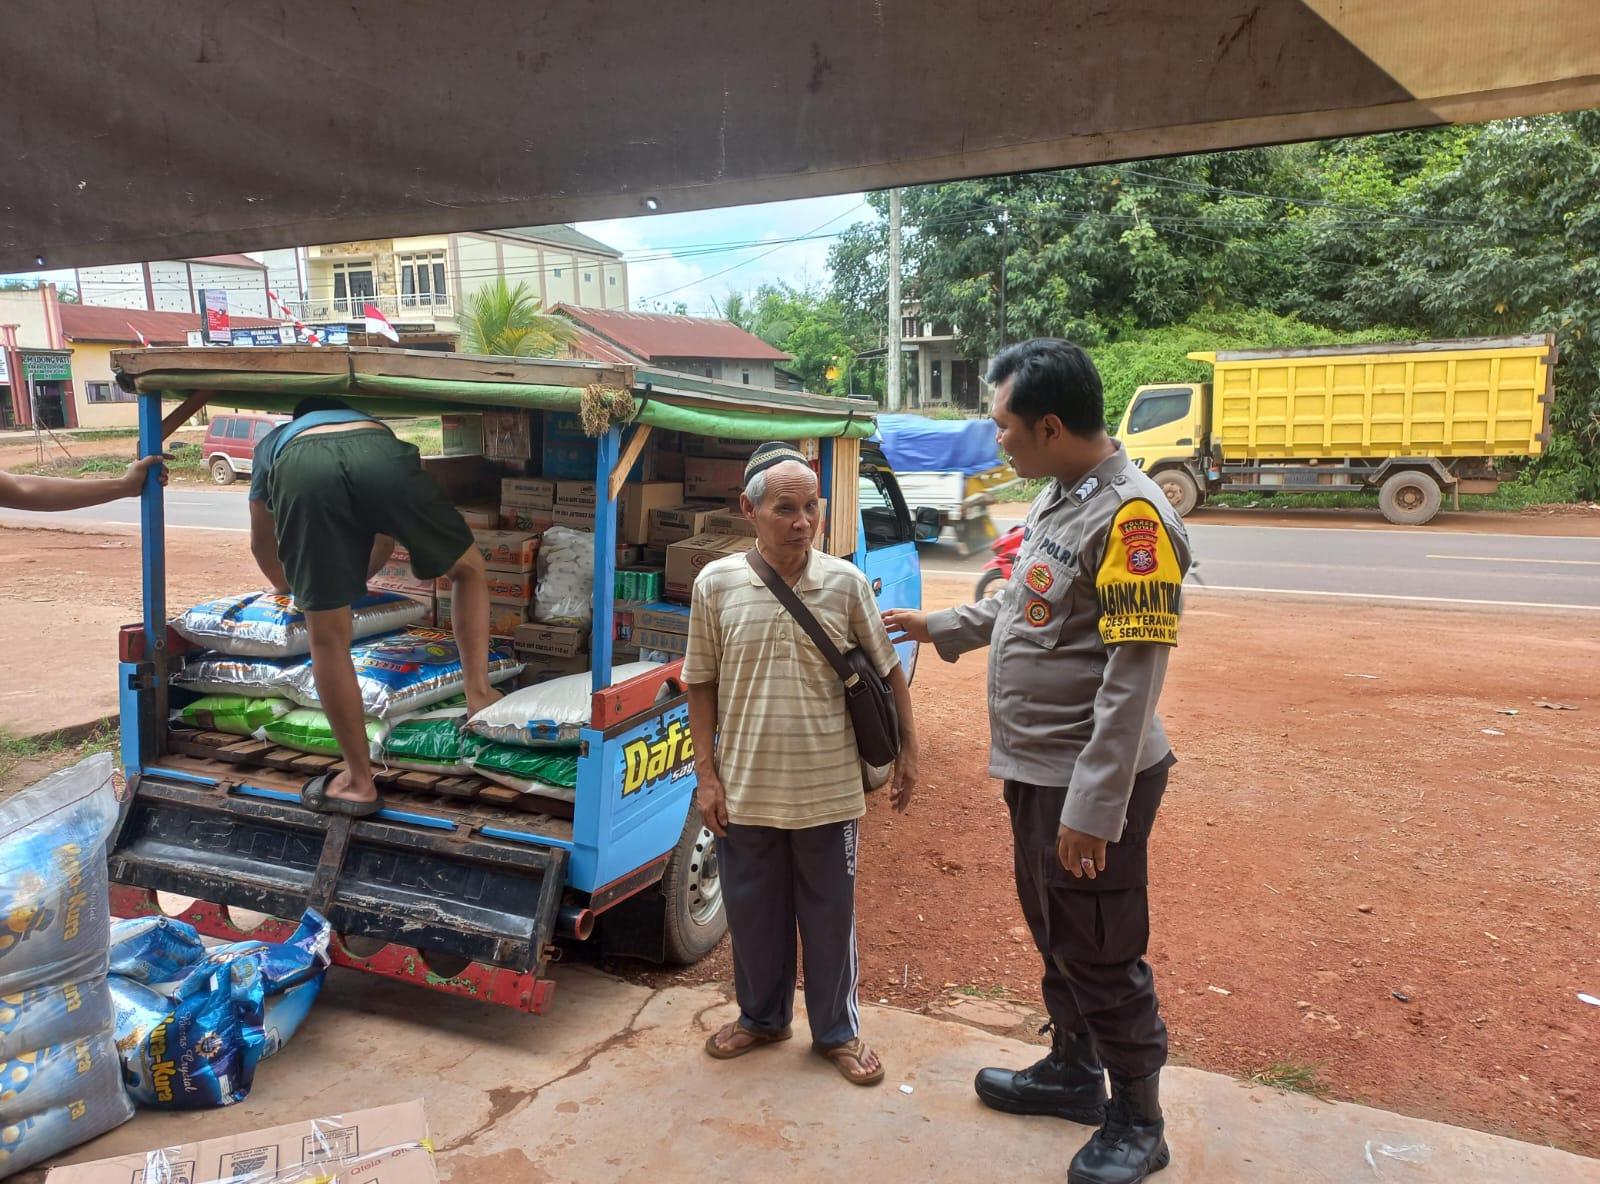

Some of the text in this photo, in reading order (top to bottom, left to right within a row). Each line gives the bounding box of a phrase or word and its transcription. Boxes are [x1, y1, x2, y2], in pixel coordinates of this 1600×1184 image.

[1040, 538, 1077, 568] POLRI
[1105, 616, 1131, 628] DESA
[1119, 626, 1166, 639] SERUYAN
[842, 823, 854, 860] YONEX
[351, 1159, 383, 1175] Qtela
